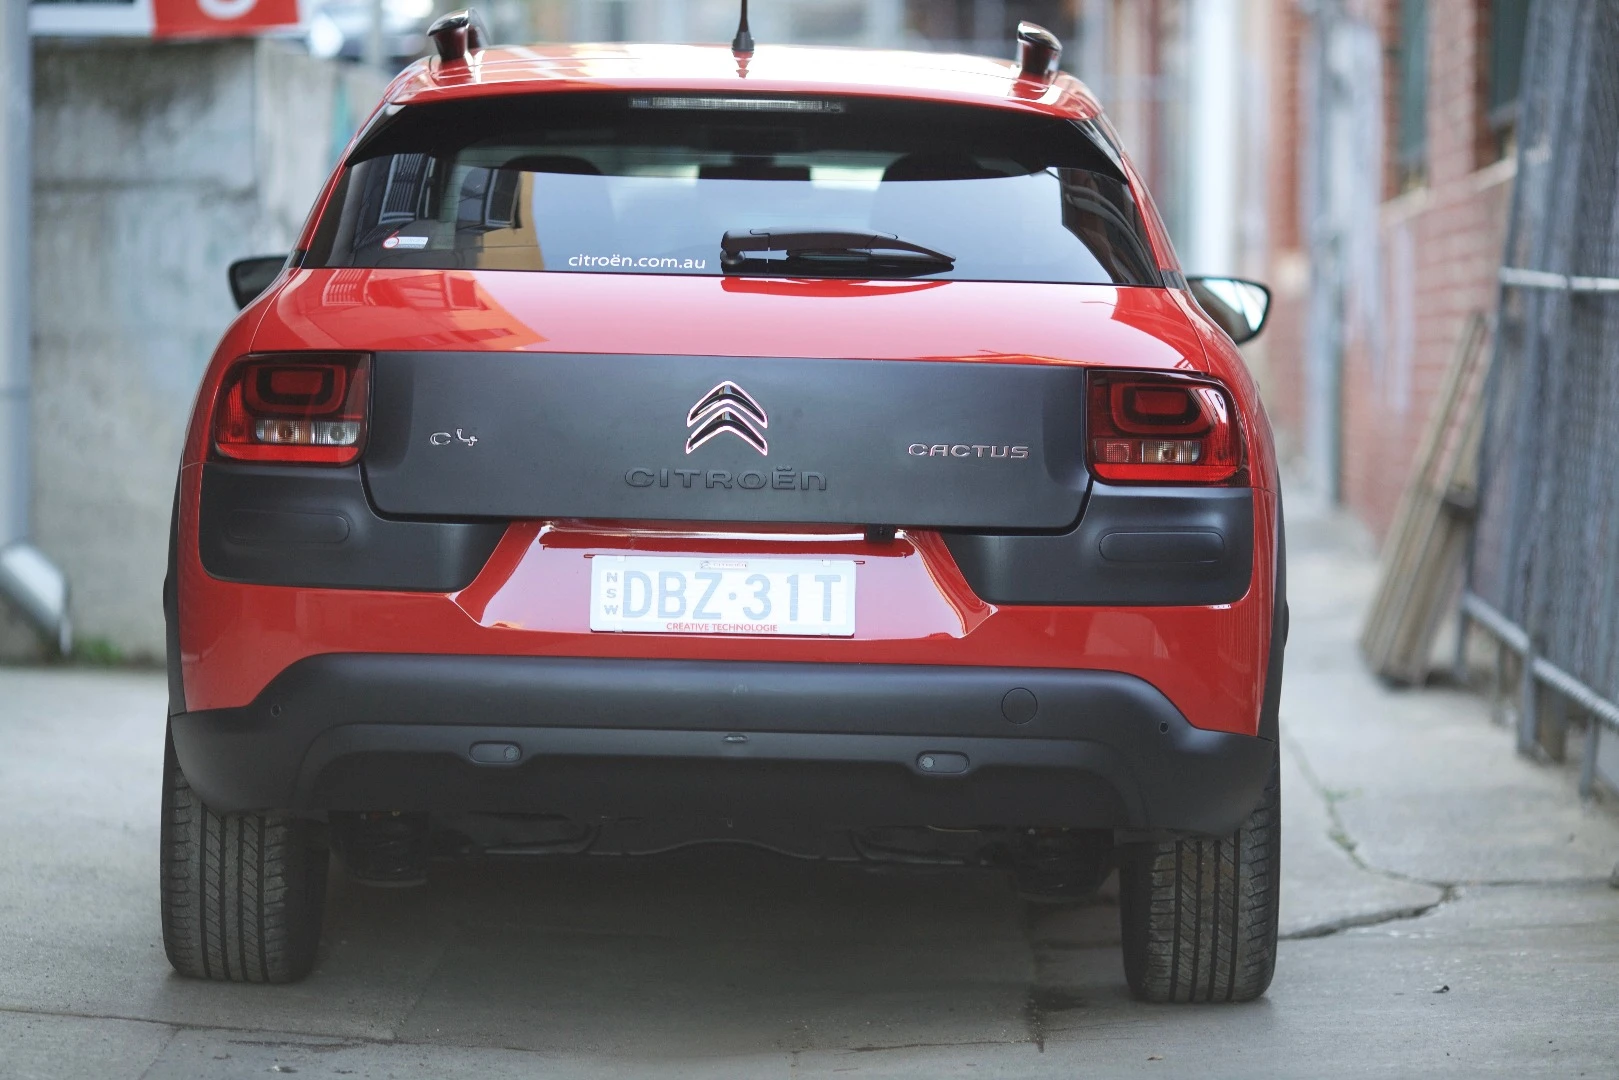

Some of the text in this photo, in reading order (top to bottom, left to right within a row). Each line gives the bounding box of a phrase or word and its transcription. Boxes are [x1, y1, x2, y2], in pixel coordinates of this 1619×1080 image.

[568, 254, 706, 269] citroën.com.au
[429, 428, 478, 447] C4
[908, 443, 1030, 459] CACTUS
[666, 622, 778, 632] CREATIVE TECHNOLOGIE
